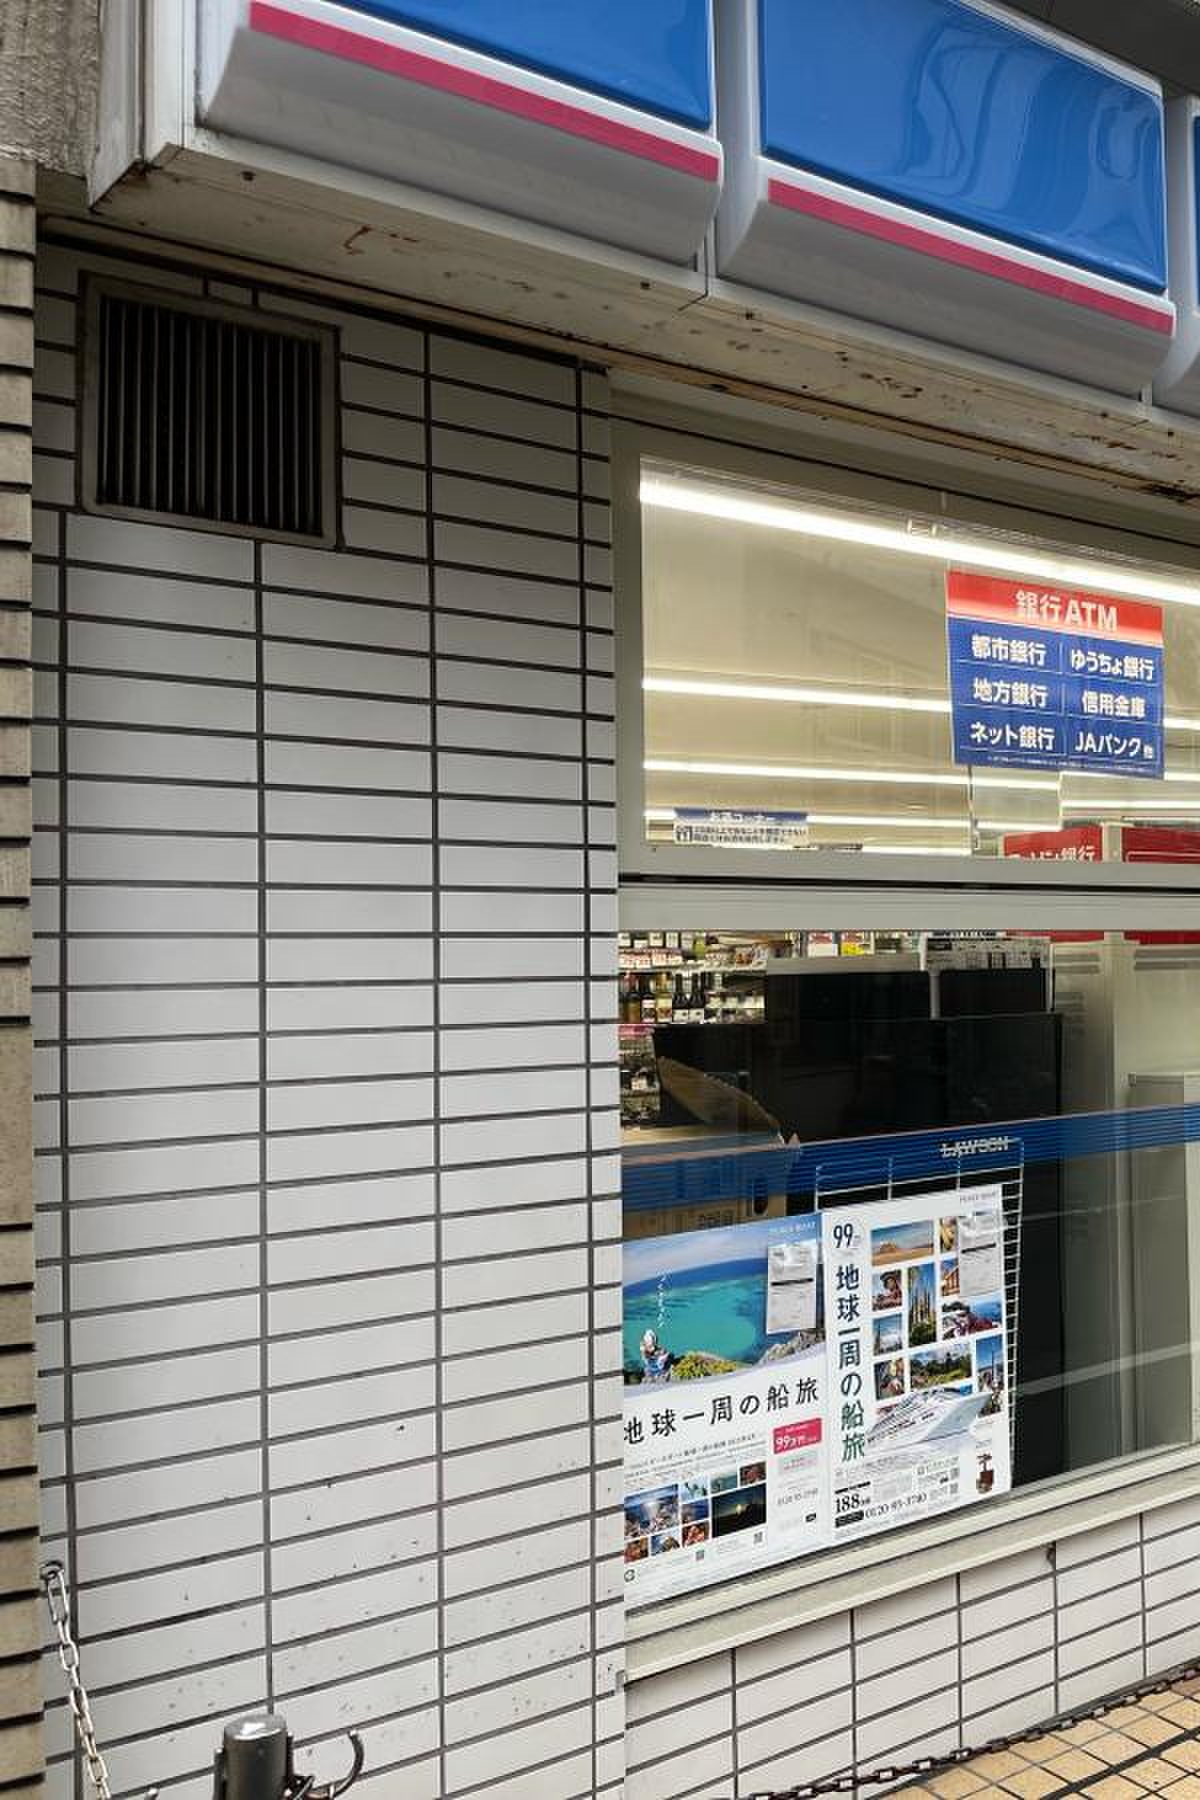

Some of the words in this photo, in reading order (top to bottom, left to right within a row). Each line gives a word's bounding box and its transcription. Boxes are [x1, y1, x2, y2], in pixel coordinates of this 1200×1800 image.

[1015, 589, 1118, 632] 銀行ATM
[971, 634, 1047, 666] 都市銀行
[1071, 650, 1155, 681] ゆうちょ銀行
[973, 677, 1048, 708] 地方銀行
[1082, 691, 1146, 719] 信用金庫
[970, 721, 1055, 752] ネット銀行
[836, 1264, 865, 1463] 地球一周の船旅
[624, 1377, 820, 1445] 地球一周の船旅
